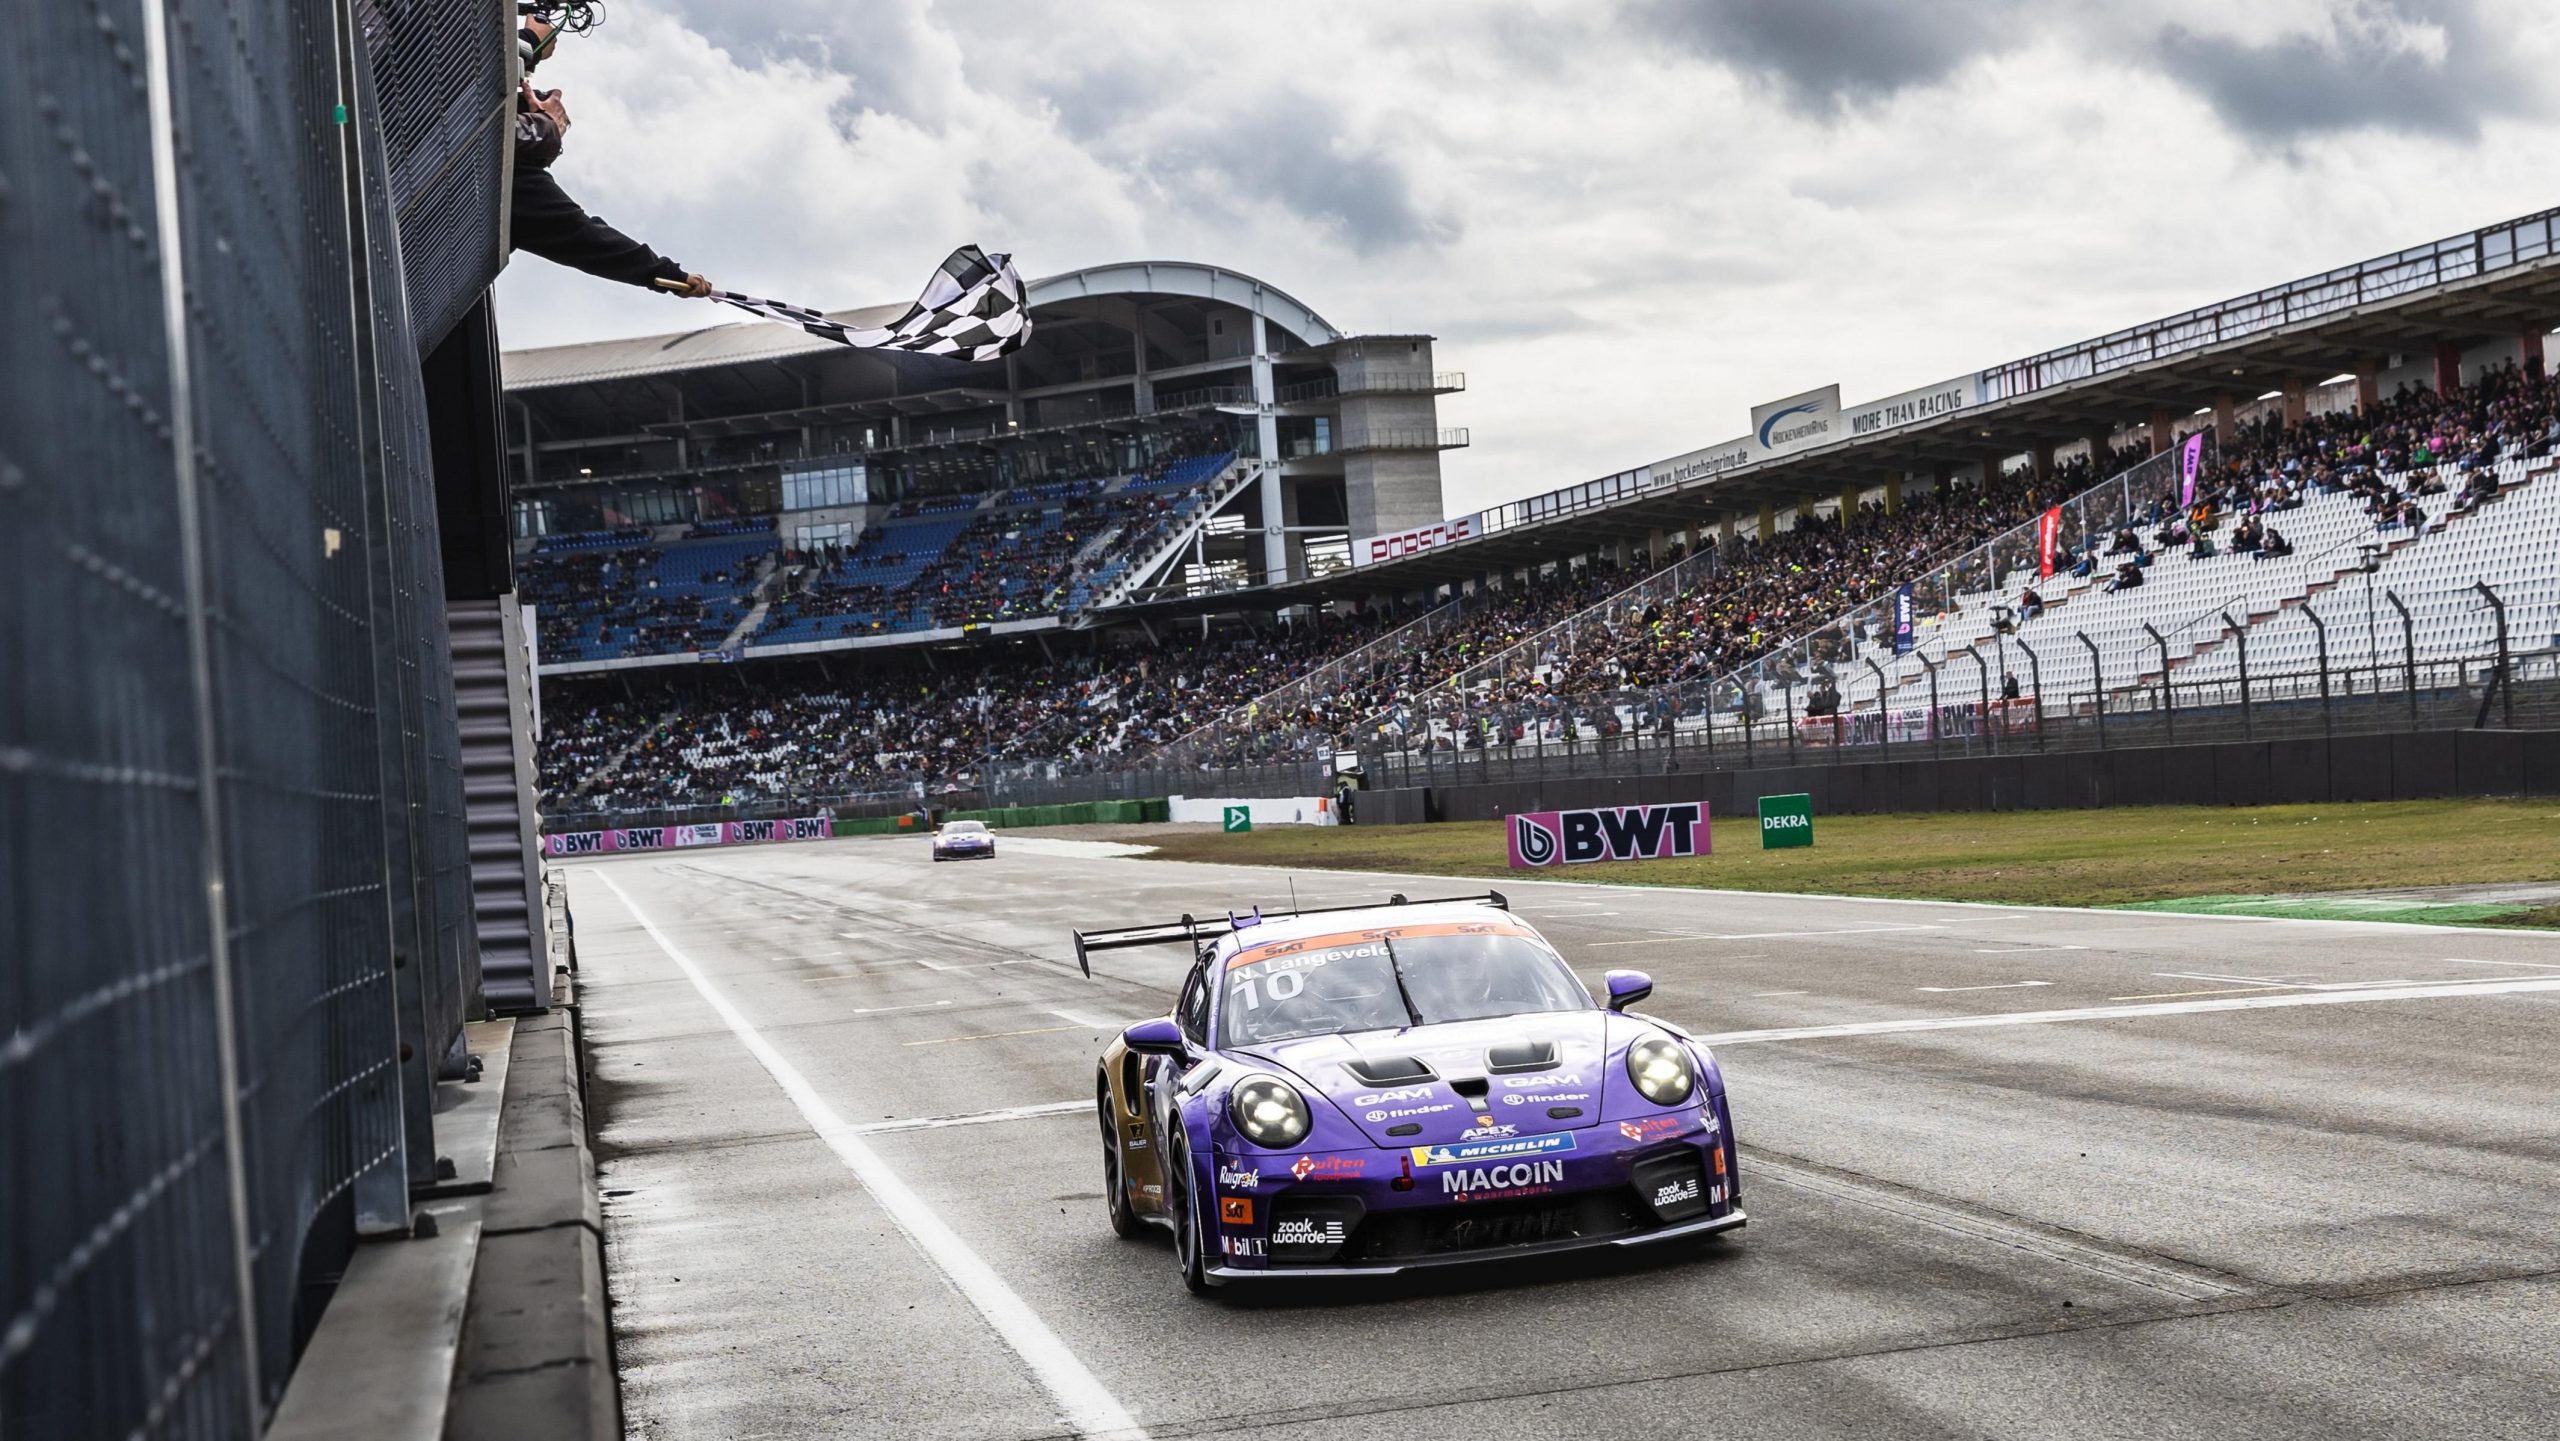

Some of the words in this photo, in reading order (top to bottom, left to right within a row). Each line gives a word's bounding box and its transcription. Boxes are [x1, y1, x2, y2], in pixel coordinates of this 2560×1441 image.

[1852, 410, 1882, 435] MORE
[1885, 401, 1916, 426] THAN
[1919, 388, 1962, 418] RACING
[2186, 447, 2196, 474] BWT
[1371, 519, 1470, 563] PORSCHE
[1899, 594, 1911, 623] BWT
[742, 820, 775, 842] BWT
[795, 816, 826, 840] BWT
[1763, 813, 1809, 830] DEKRA
[566, 832, 602, 853] BWT
[628, 828, 664, 849] BWT
[1560, 803, 1701, 863] BWT
[1230, 970, 1304, 1011] 10
[1503, 1073, 1583, 1088] GAM
[1353, 1087, 1433, 1107] GAM
[1526, 1093, 1590, 1103] finder
[1389, 1103, 1454, 1118] finder
[1461, 1124, 1518, 1139] APEX
[1460, 1137, 1561, 1157] MICHELIN
[1296, 1156, 1365, 1175] Ruiten
[1442, 1159, 1564, 1194] MACOIN
[1654, 1190, 1688, 1207] waarde
[1657, 1181, 1680, 1197] zaak
[1278, 1218, 1314, 1233] zaak
[1221, 1235, 1250, 1256] Mobil
[1272, 1231, 1326, 1244] waarde
